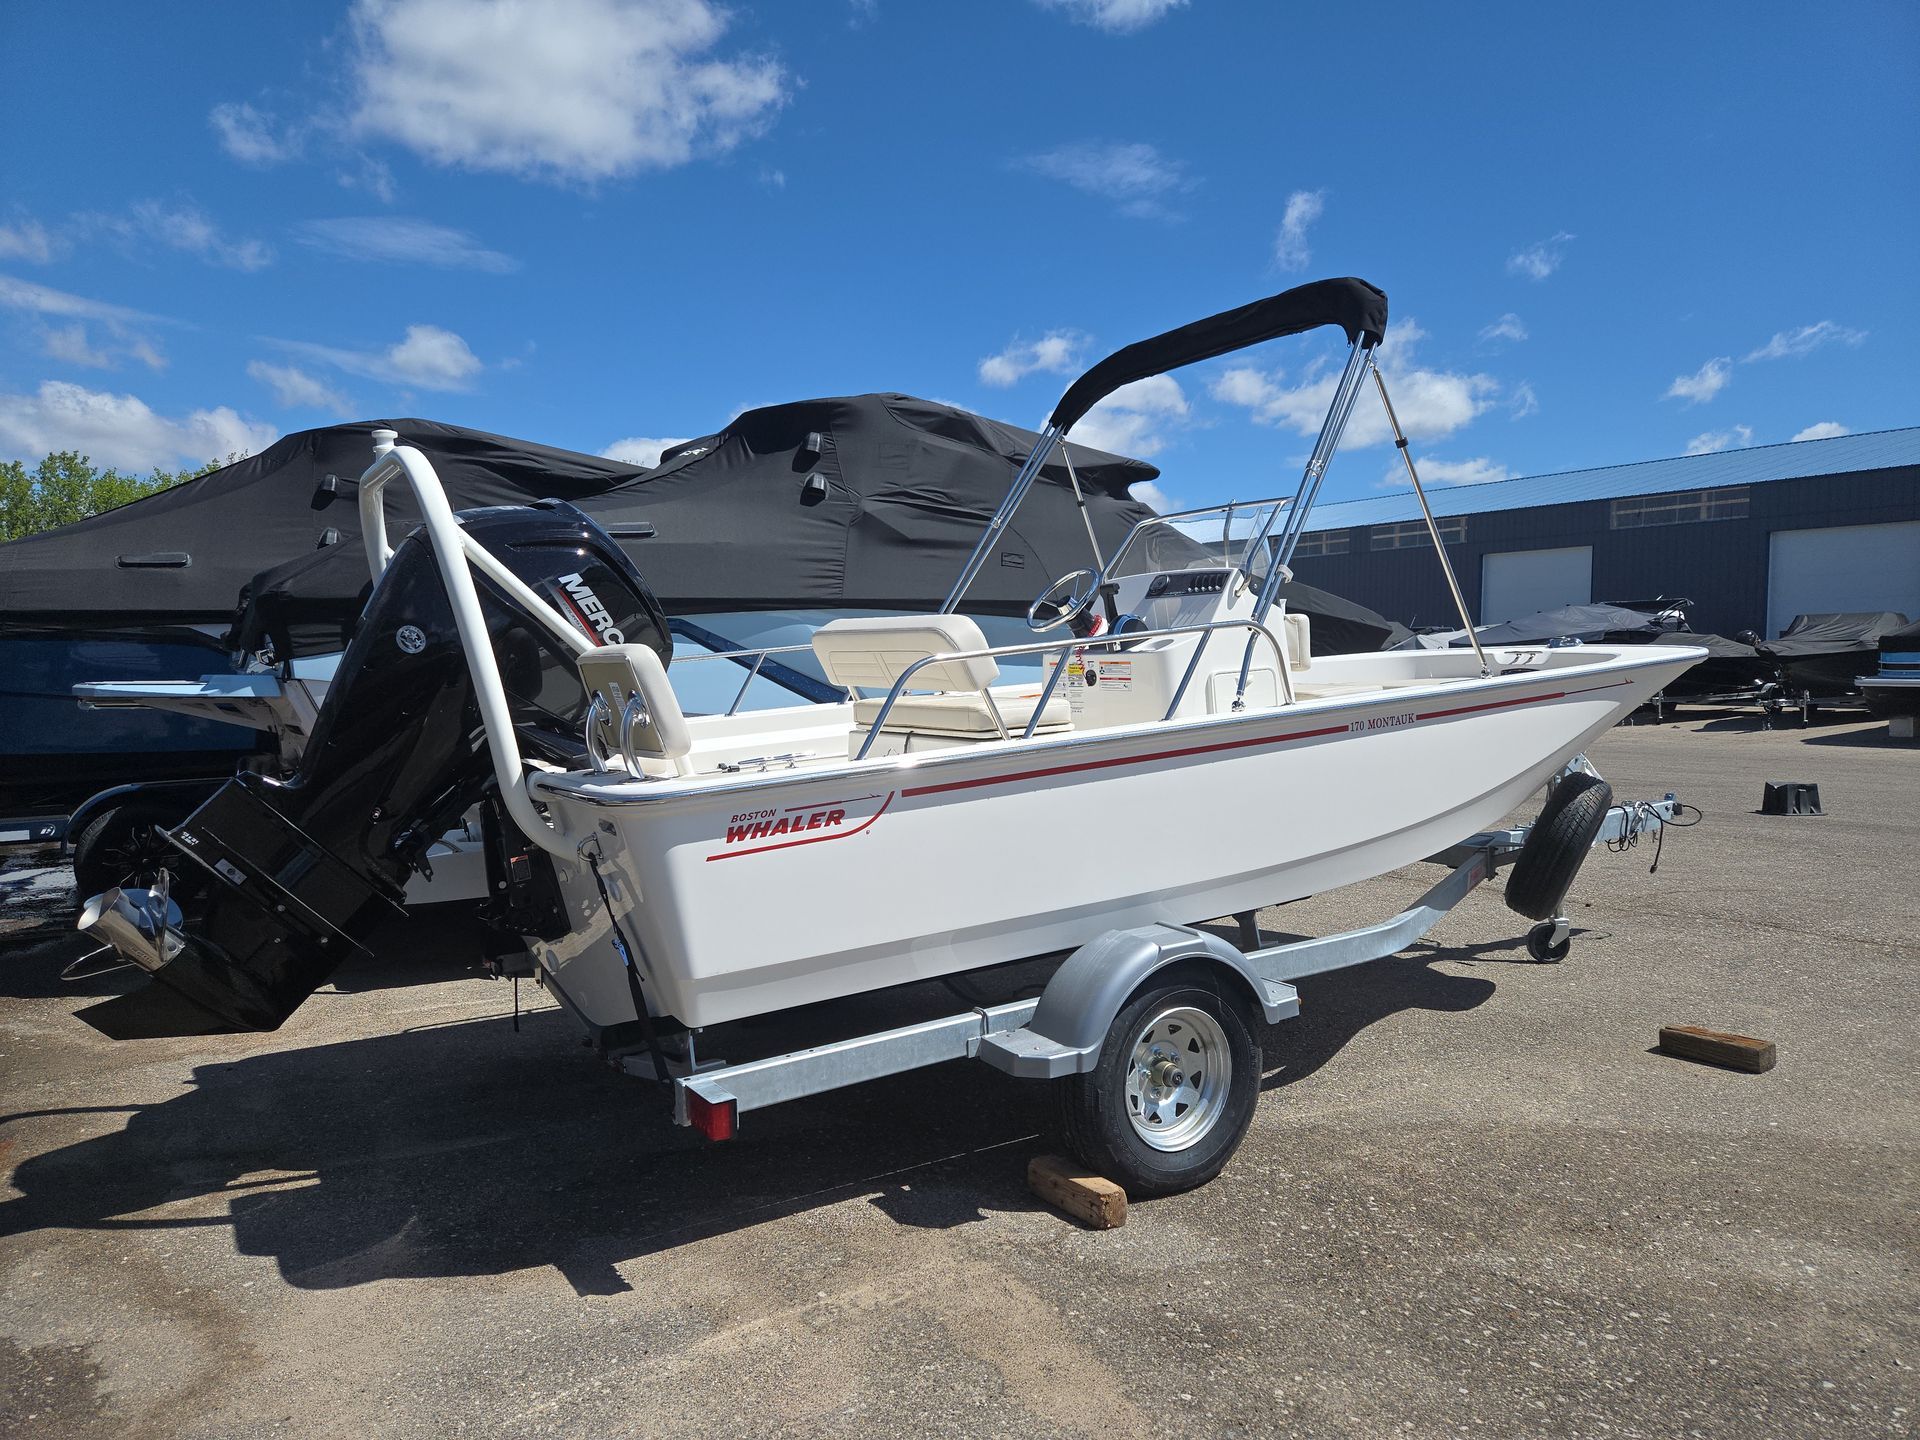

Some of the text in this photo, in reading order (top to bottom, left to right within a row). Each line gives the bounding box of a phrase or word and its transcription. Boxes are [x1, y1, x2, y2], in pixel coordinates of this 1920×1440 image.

[1350, 713, 1415, 732] 170 MONTAUK
[730, 808, 777, 824] BOSTON
[725, 809, 846, 844] WHALER
